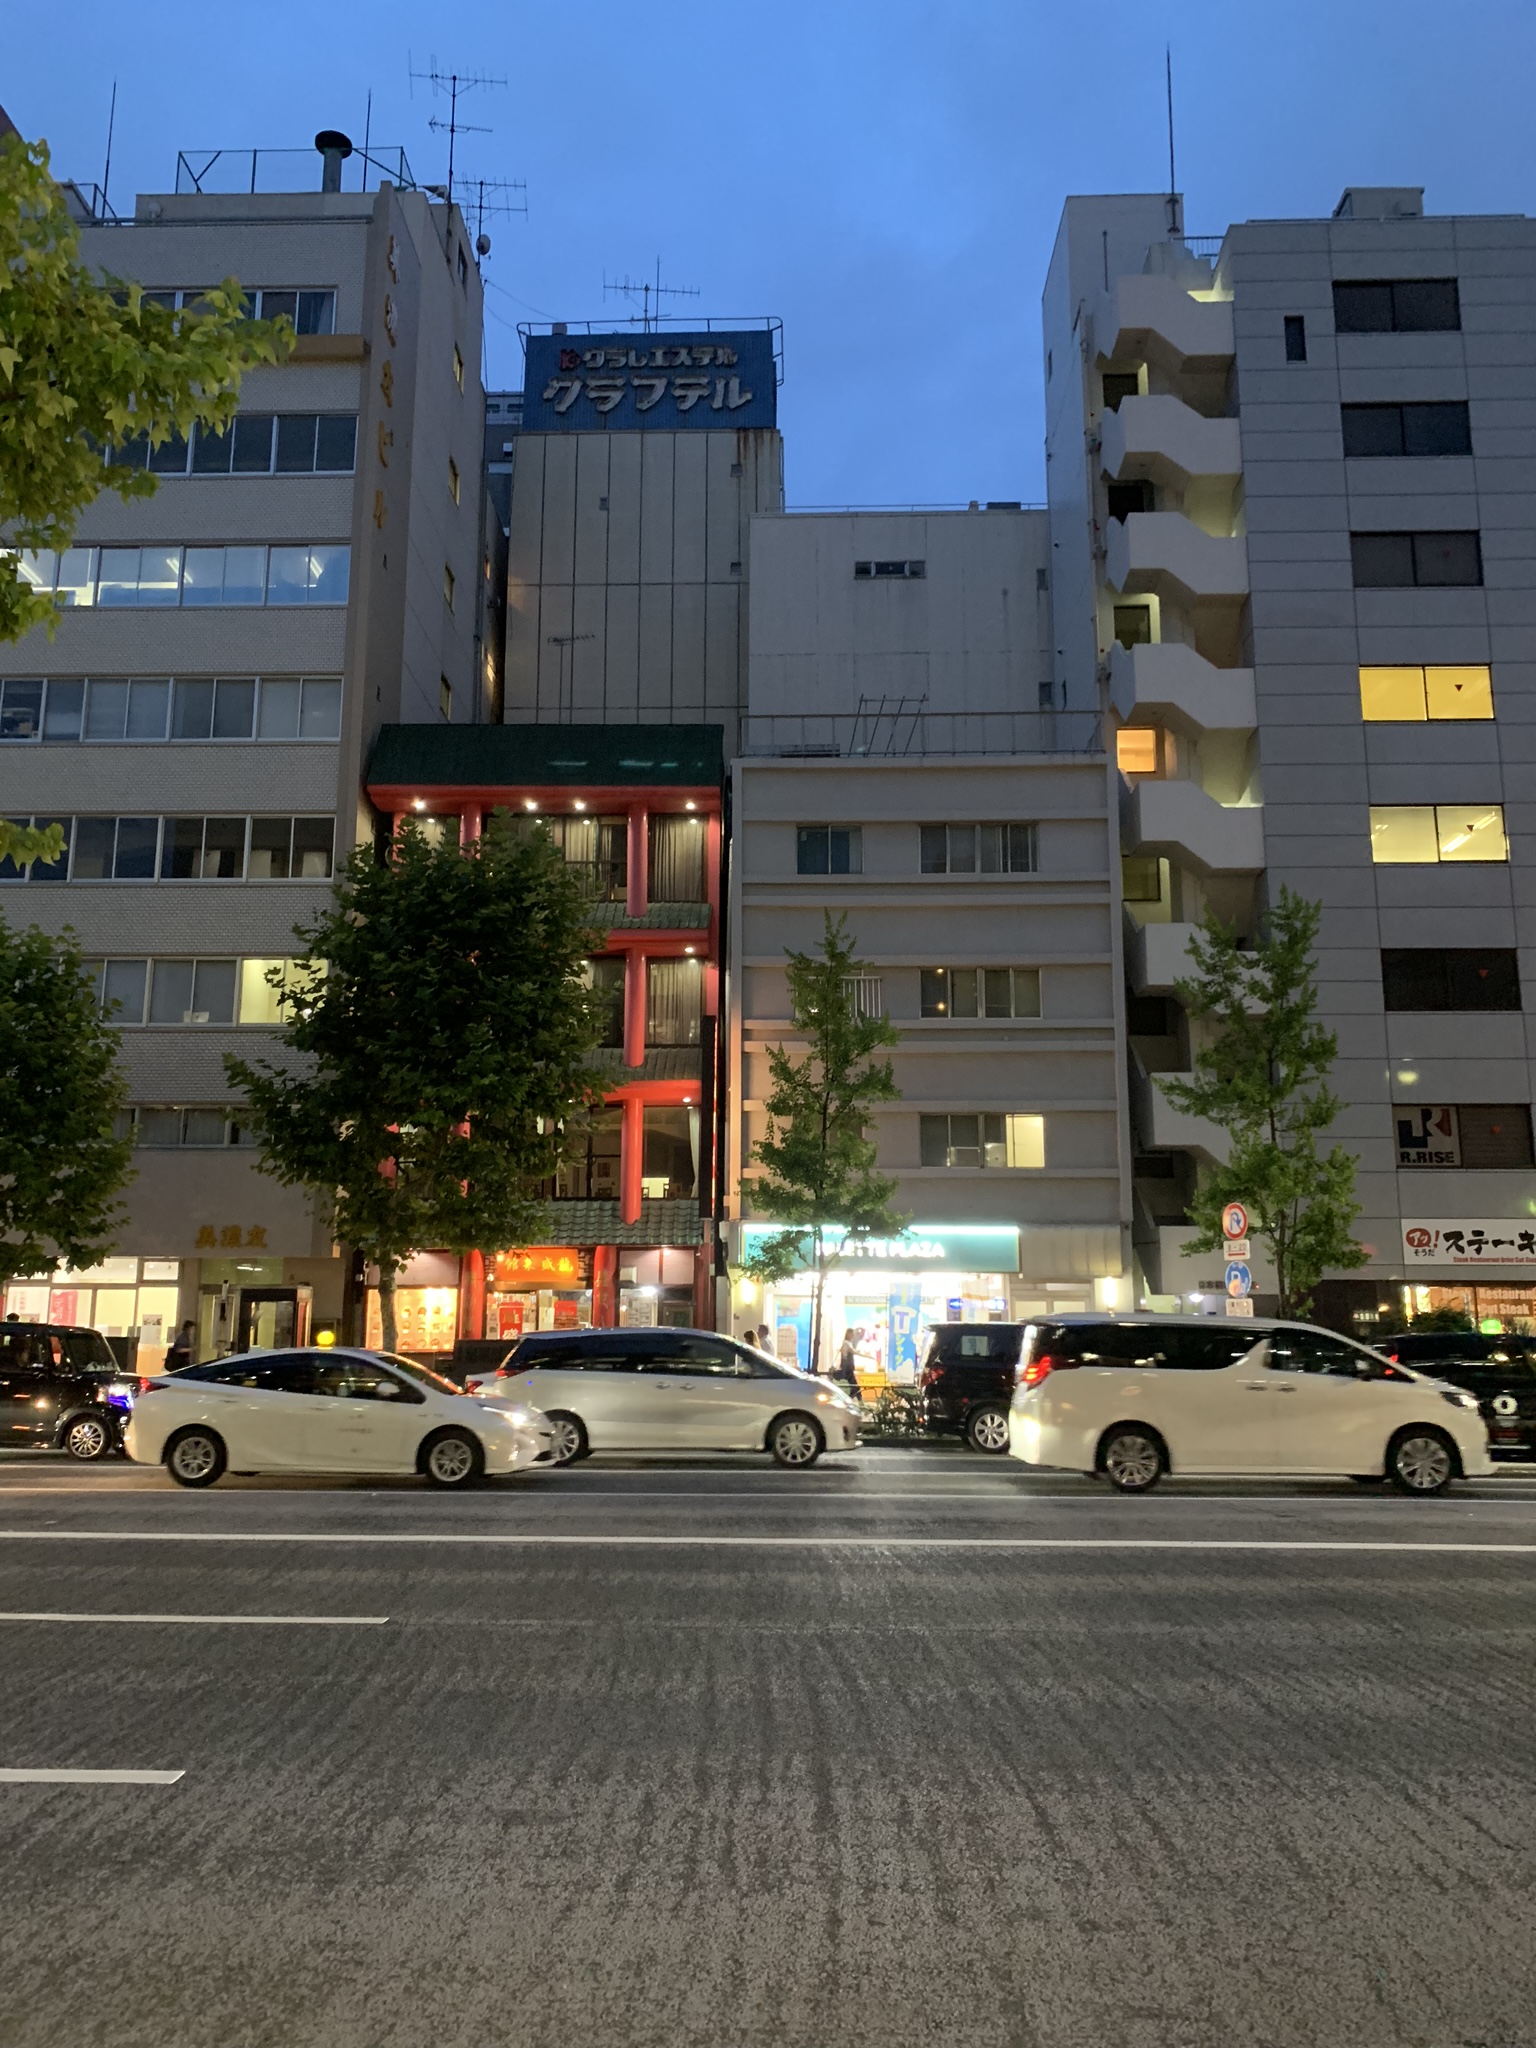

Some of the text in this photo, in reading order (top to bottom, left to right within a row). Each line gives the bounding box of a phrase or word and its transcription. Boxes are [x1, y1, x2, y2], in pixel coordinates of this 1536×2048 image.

[542, 375, 753, 413] クラフテル
[1400, 1151, 1455, 1163] R.RISE
[889, 1241, 945, 1257] PLAZA
[1443, 1230, 1536, 1255] ステーキ
[1499, 1303, 1530, 1315] Steak
